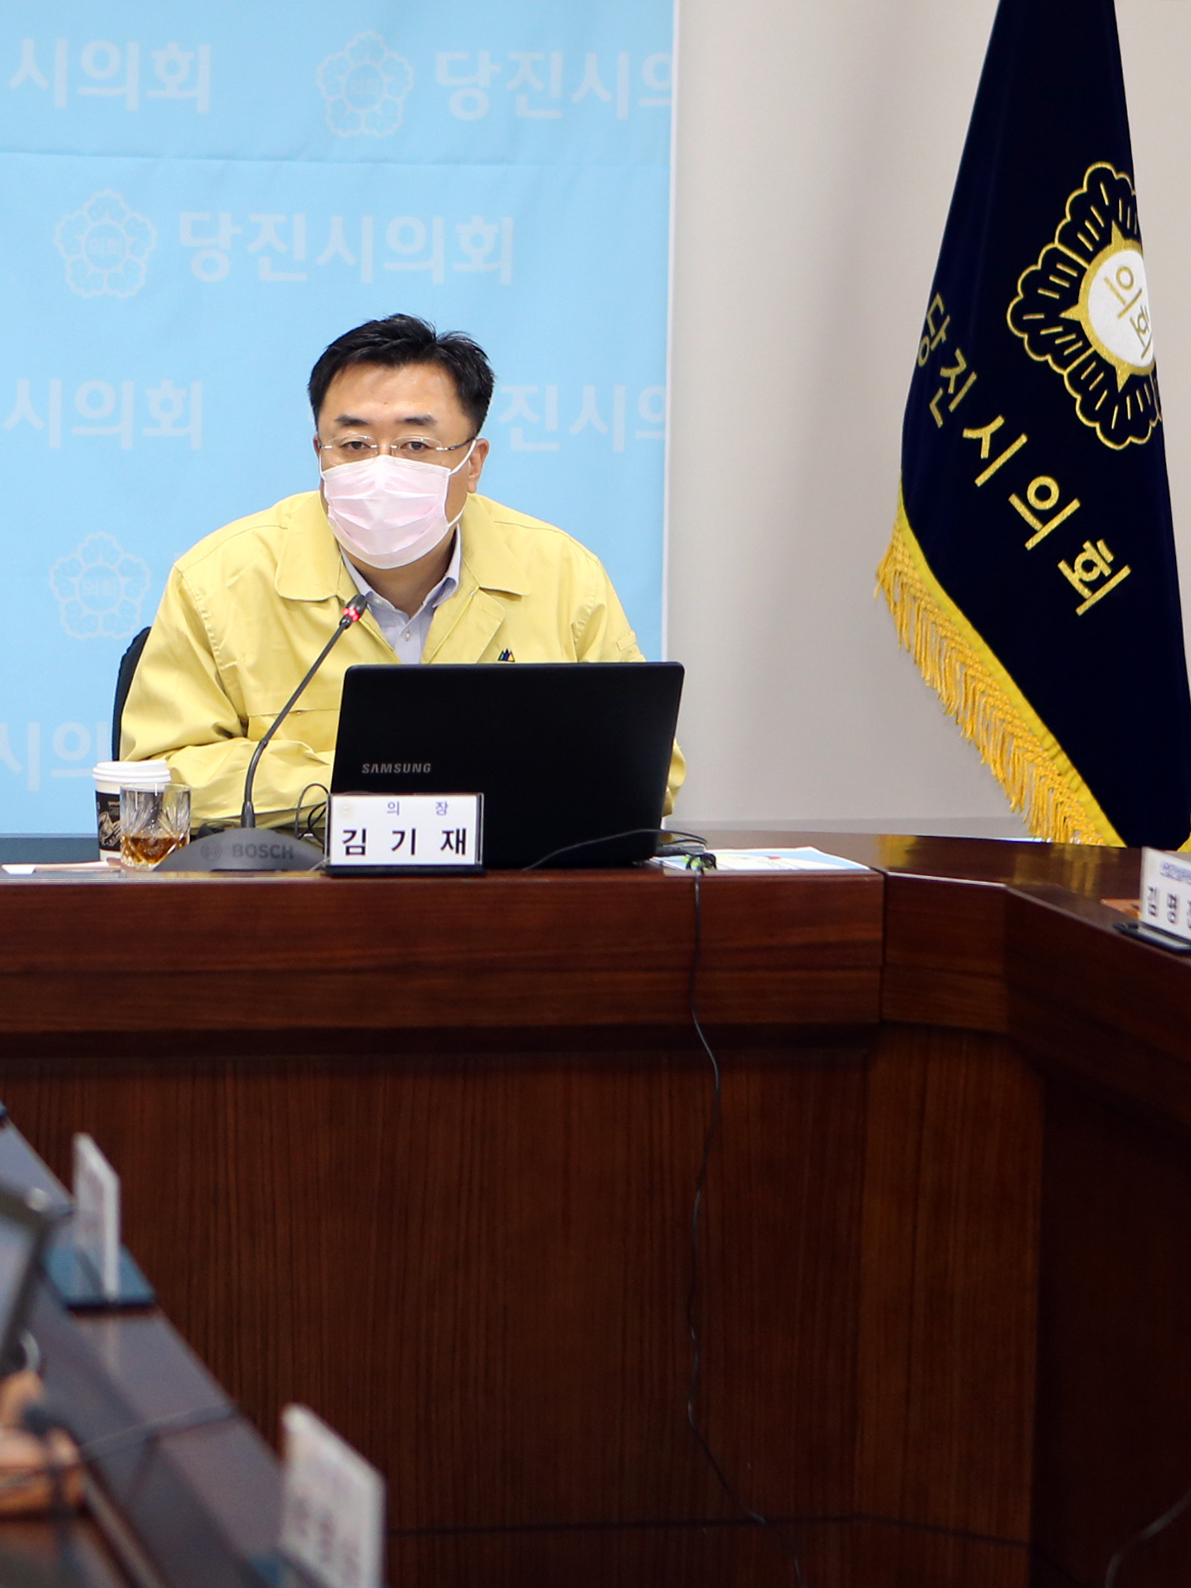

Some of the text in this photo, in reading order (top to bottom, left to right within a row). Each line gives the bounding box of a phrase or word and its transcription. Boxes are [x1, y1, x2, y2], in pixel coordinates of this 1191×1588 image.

[179, 211, 514, 285] 당진시의회
[918, 292, 1131, 616] 당진시의회
[361, 763, 432, 775] SAMSUNG
[232, 843, 295, 861] BOSCH
